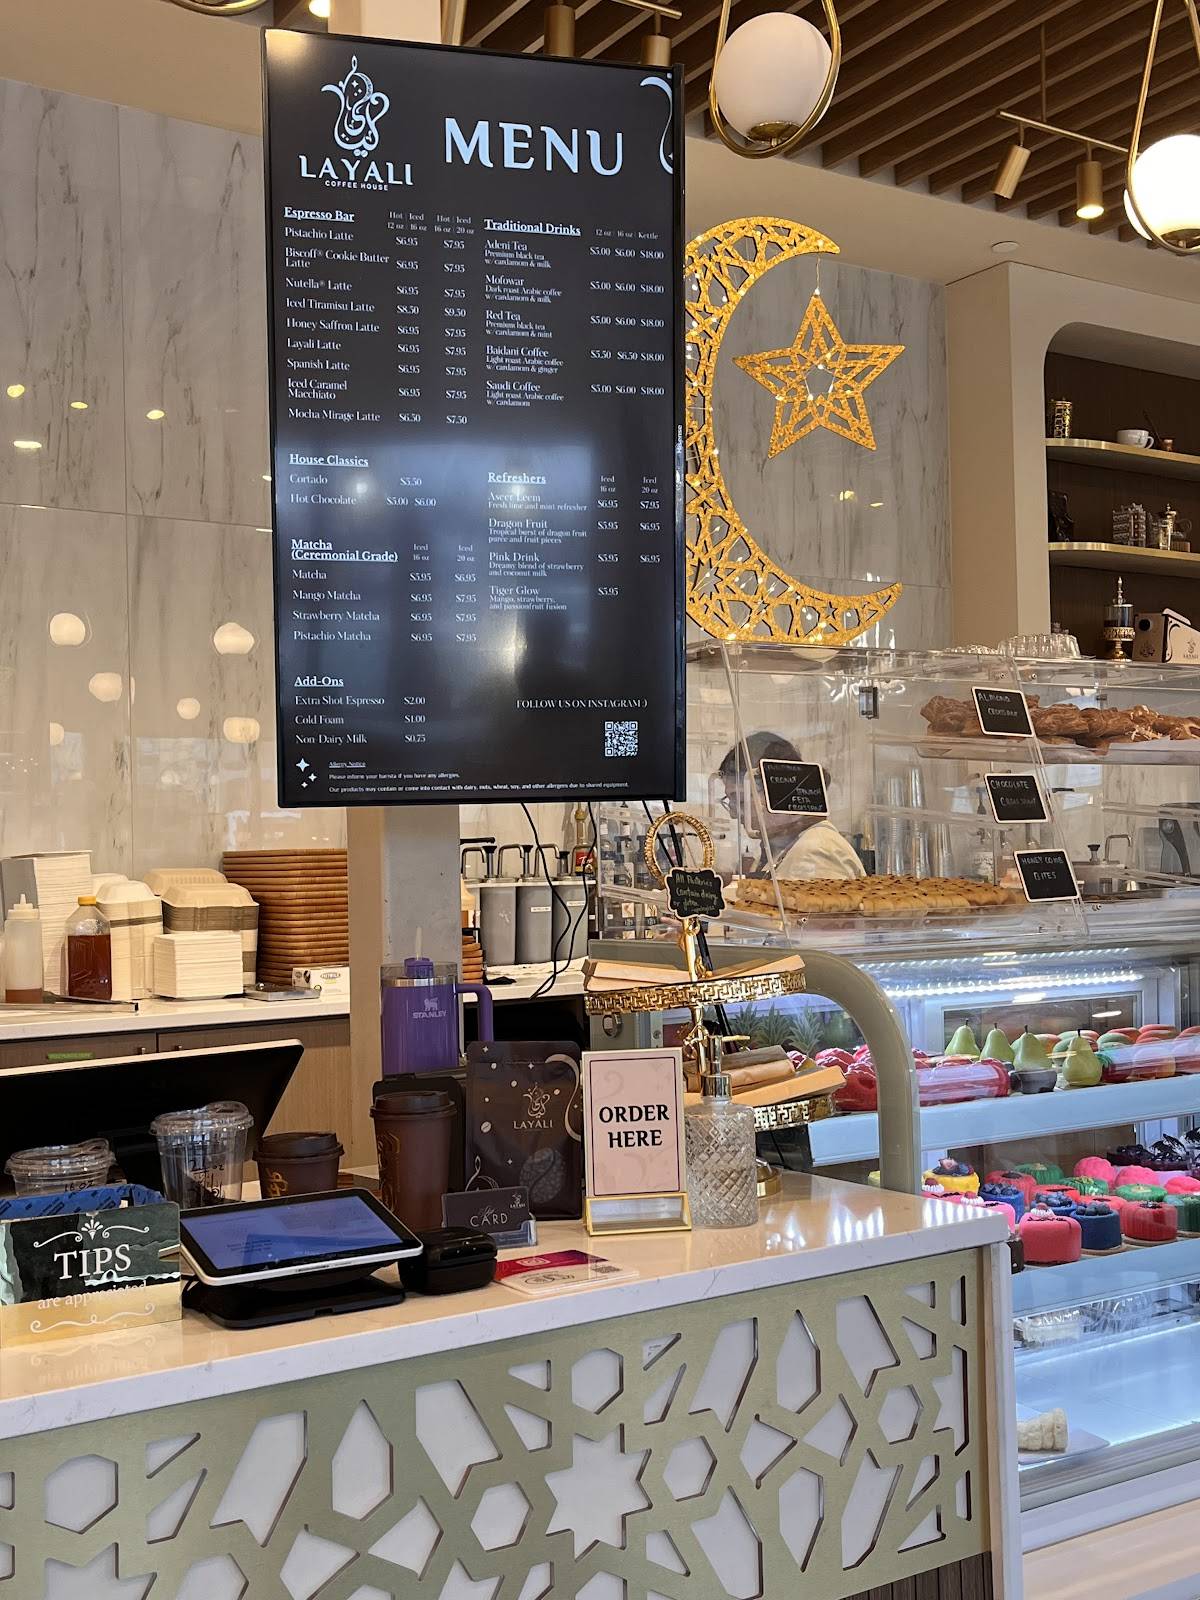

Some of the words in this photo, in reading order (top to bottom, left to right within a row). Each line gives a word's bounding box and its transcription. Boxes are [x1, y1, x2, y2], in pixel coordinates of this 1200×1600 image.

[444, 116, 624, 176] MENU
[299, 155, 413, 185] LAYALI
[325, 180, 358, 188] COFFEE
[361, 183, 388, 191] HOUSE
[284, 206, 333, 221] Espresso
[335, 210, 355, 222] Bar
[484, 219, 542, 234] Traditional
[546, 223, 581, 236] Drinks
[284, 227, 327, 240] Pistachio
[329, 229, 354, 241] Latte
[485, 239, 510, 250] Adeni
[513, 241, 528, 251] Tea
[285, 257, 310, 268] Latte
[325, 249, 358, 261] Cookie
[359, 253, 389, 264] Butter
[328, 280, 352, 291] Latte
[485, 274, 524, 286] Mofowar
[286, 298, 305, 308] Iced
[307, 298, 348, 311] Tiramisu
[350, 301, 375, 313] Latte
[486, 310, 503, 320] Red
[506, 311, 521, 321] Tea
[287, 318, 318, 331] Honey
[319, 320, 353, 331] Saffron
[355, 322, 380, 333] Latte
[287, 337, 315, 350] Layali
[317, 339, 342, 350] Latte
[521, 347, 549, 357] Coffee
[287, 358, 323, 370] Spanish
[326, 360, 350, 371] Latte
[288, 378, 307, 389] Iced
[309, 379, 348, 391] Caramel
[486, 380, 510, 390] Saudi
[513, 382, 541, 392] Coffee
[288, 388, 336, 400] Macchiato
[288, 408, 320, 419] Mocha
[323, 409, 354, 422] Mirage
[356, 411, 381, 422] Latte
[289, 454, 324, 465] House
[327, 455, 369, 467] Classics
[289, 474, 328, 485] Cortado
[488, 471, 546, 484] Refreshers
[290, 494, 308, 504] Hot
[311, 495, 357, 505] Chocolate
[488, 518, 523, 529] Dragon
[525, 519, 548, 529] Fruit
[291, 539, 333, 550] Matcha
[291, 549, 359, 561] (Ceremonial
[361, 551, 399, 563] Grade)
[489, 552, 510, 562] Pink
[513, 553, 540, 562] Drink
[292, 569, 327, 580] Matcha
[293, 590, 325, 602] Mango
[327, 590, 361, 601] Matcha
[489, 586, 514, 597] Tiger
[516, 586, 539, 596] Glow
[293, 610, 343, 622] Strawberry
[346, 610, 380, 621] Matcha
[293, 630, 336, 641] Pistachio
[338, 631, 372, 641] Matcha
[294, 676, 344, 687] Add-Ons
[295, 696, 320, 705] Extra
[322, 696, 343, 705] Shot
[346, 696, 385, 707] Espresso
[516, 699, 556, 708] FOLLOW
[559, 700, 571, 708] US
[571, 700, 586, 708] ON
[588, 699, 641, 708] INSTAGRAM
[295, 715, 317, 725] Cold
[319, 716, 344, 724] Foam
[318, 734, 343, 745] Dairy
[346, 734, 368, 744] Milk
[1033, 871, 1056, 880] BITES
[412, 1010, 447, 1018] STANLEY
[599, 1104, 669, 1123] ORDER
[513, 1120, 553, 1130] LAYALI
[608, 1129, 663, 1149] HERE
[470, 1213, 507, 1227] CARD
[53, 1243, 131, 1280] TIPS
[38, 1297, 62, 1310] are
